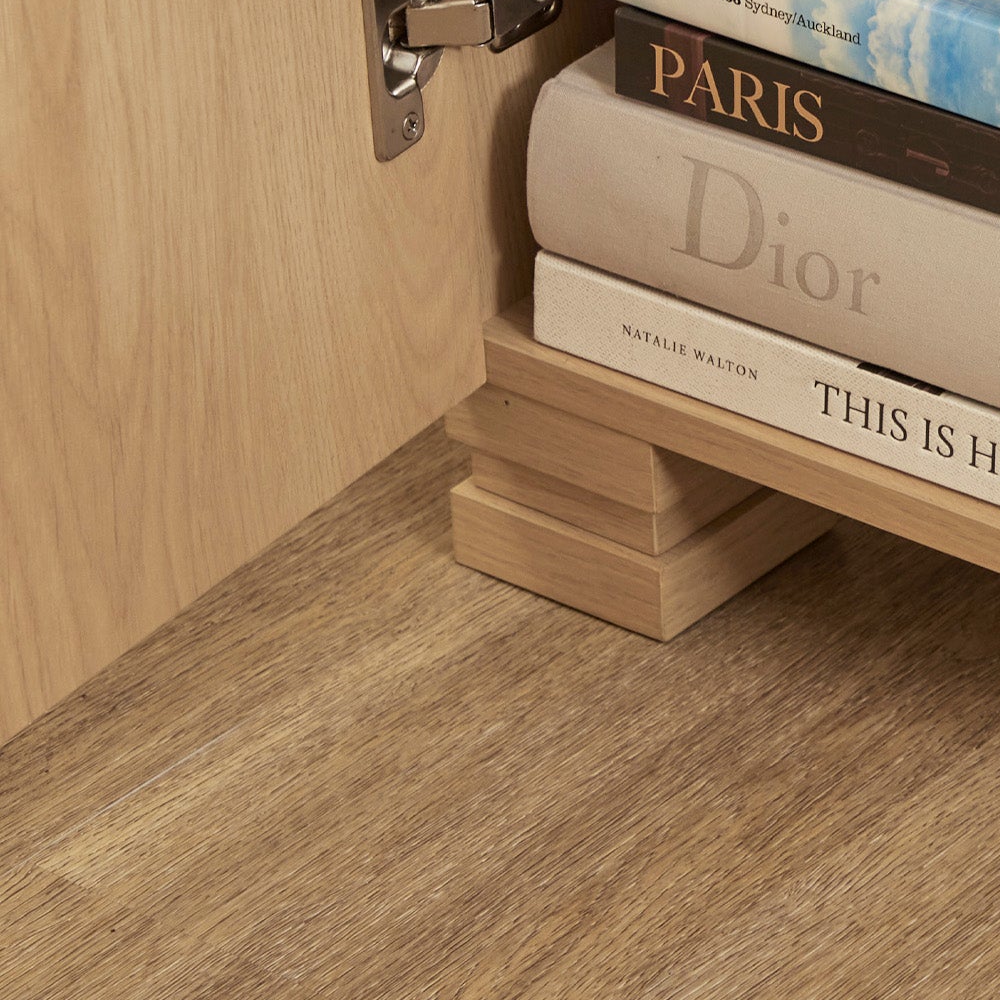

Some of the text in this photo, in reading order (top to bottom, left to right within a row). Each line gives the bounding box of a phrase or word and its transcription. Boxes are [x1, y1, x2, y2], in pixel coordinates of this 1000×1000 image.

[649, 42, 825, 144] PARIS
[669, 154, 881, 317] Dior
[622, 323, 758, 381] NATALIE WALTON
[814, 379, 908, 442] THIS
[922, 417, 955, 459] IS
